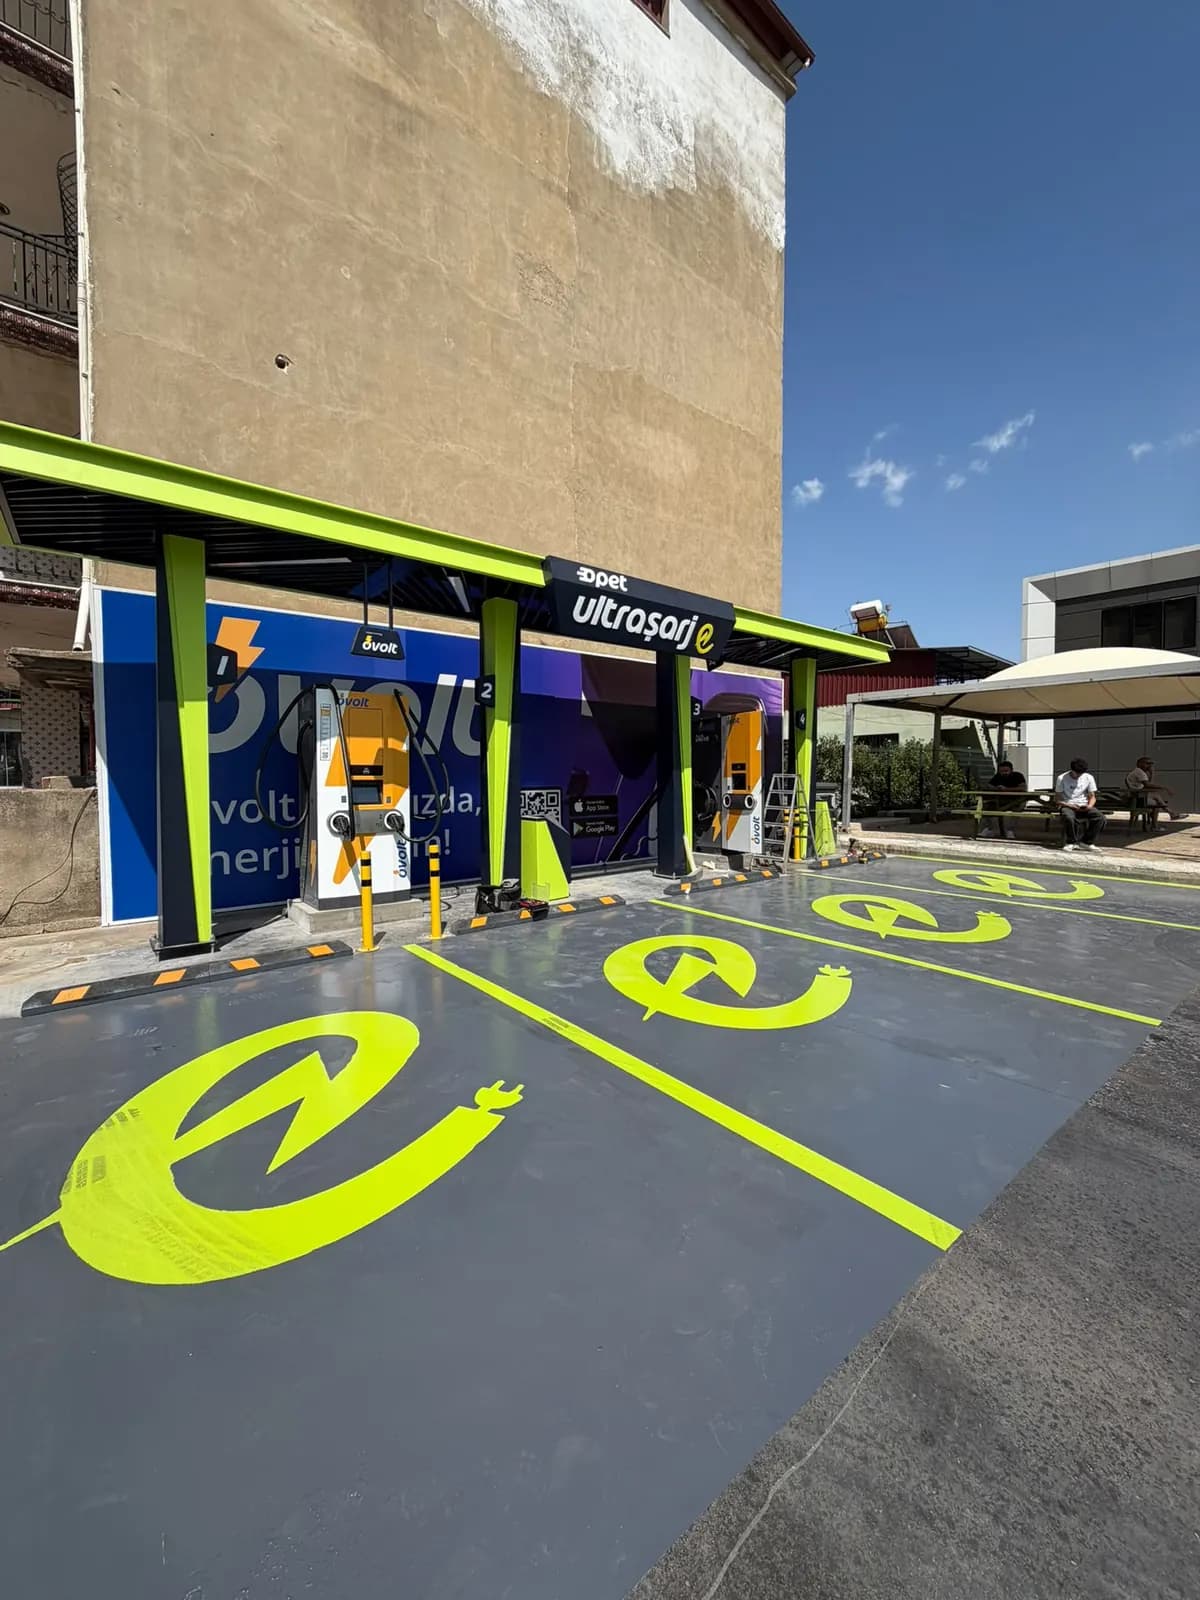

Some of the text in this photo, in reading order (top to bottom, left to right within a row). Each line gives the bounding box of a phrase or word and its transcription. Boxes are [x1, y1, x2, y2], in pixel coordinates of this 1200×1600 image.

[572, 595, 699, 650] ultraşarj
[480, 682, 493, 699] 2
[692, 703, 701, 716] 3
[799, 712, 806, 725] 4
[211, 789, 296, 825] volt
